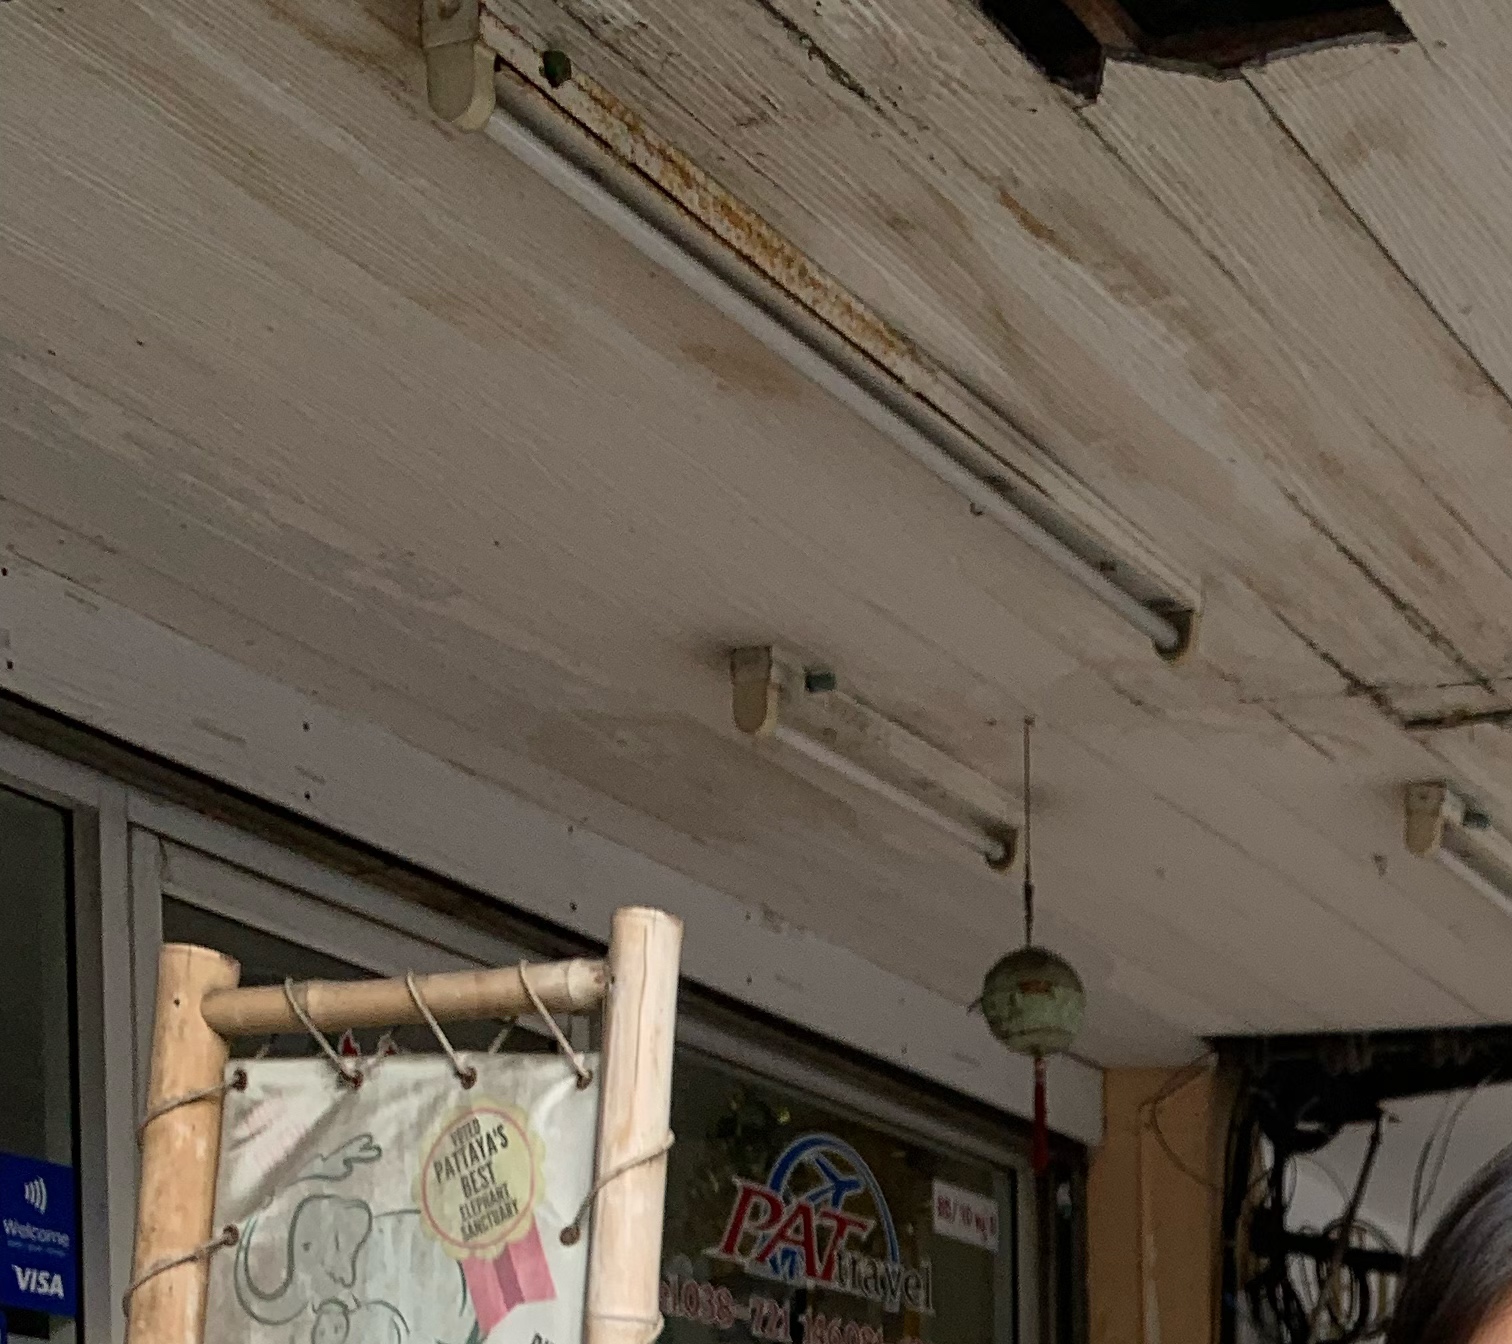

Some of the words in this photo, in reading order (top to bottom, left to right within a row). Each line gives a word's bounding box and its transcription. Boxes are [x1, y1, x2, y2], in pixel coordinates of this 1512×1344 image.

[433, 1124, 508, 1184] PATTAYA'S
[460, 1160, 496, 1198] BEST
[459, 1182, 512, 1222] ELEPHANT
[460, 1198, 520, 1242] SANCTUARY
[3, 1218, 70, 1248] Welcome
[703, 1175, 876, 1285] PAT
[12, 1264, 64, 1299] VISA
